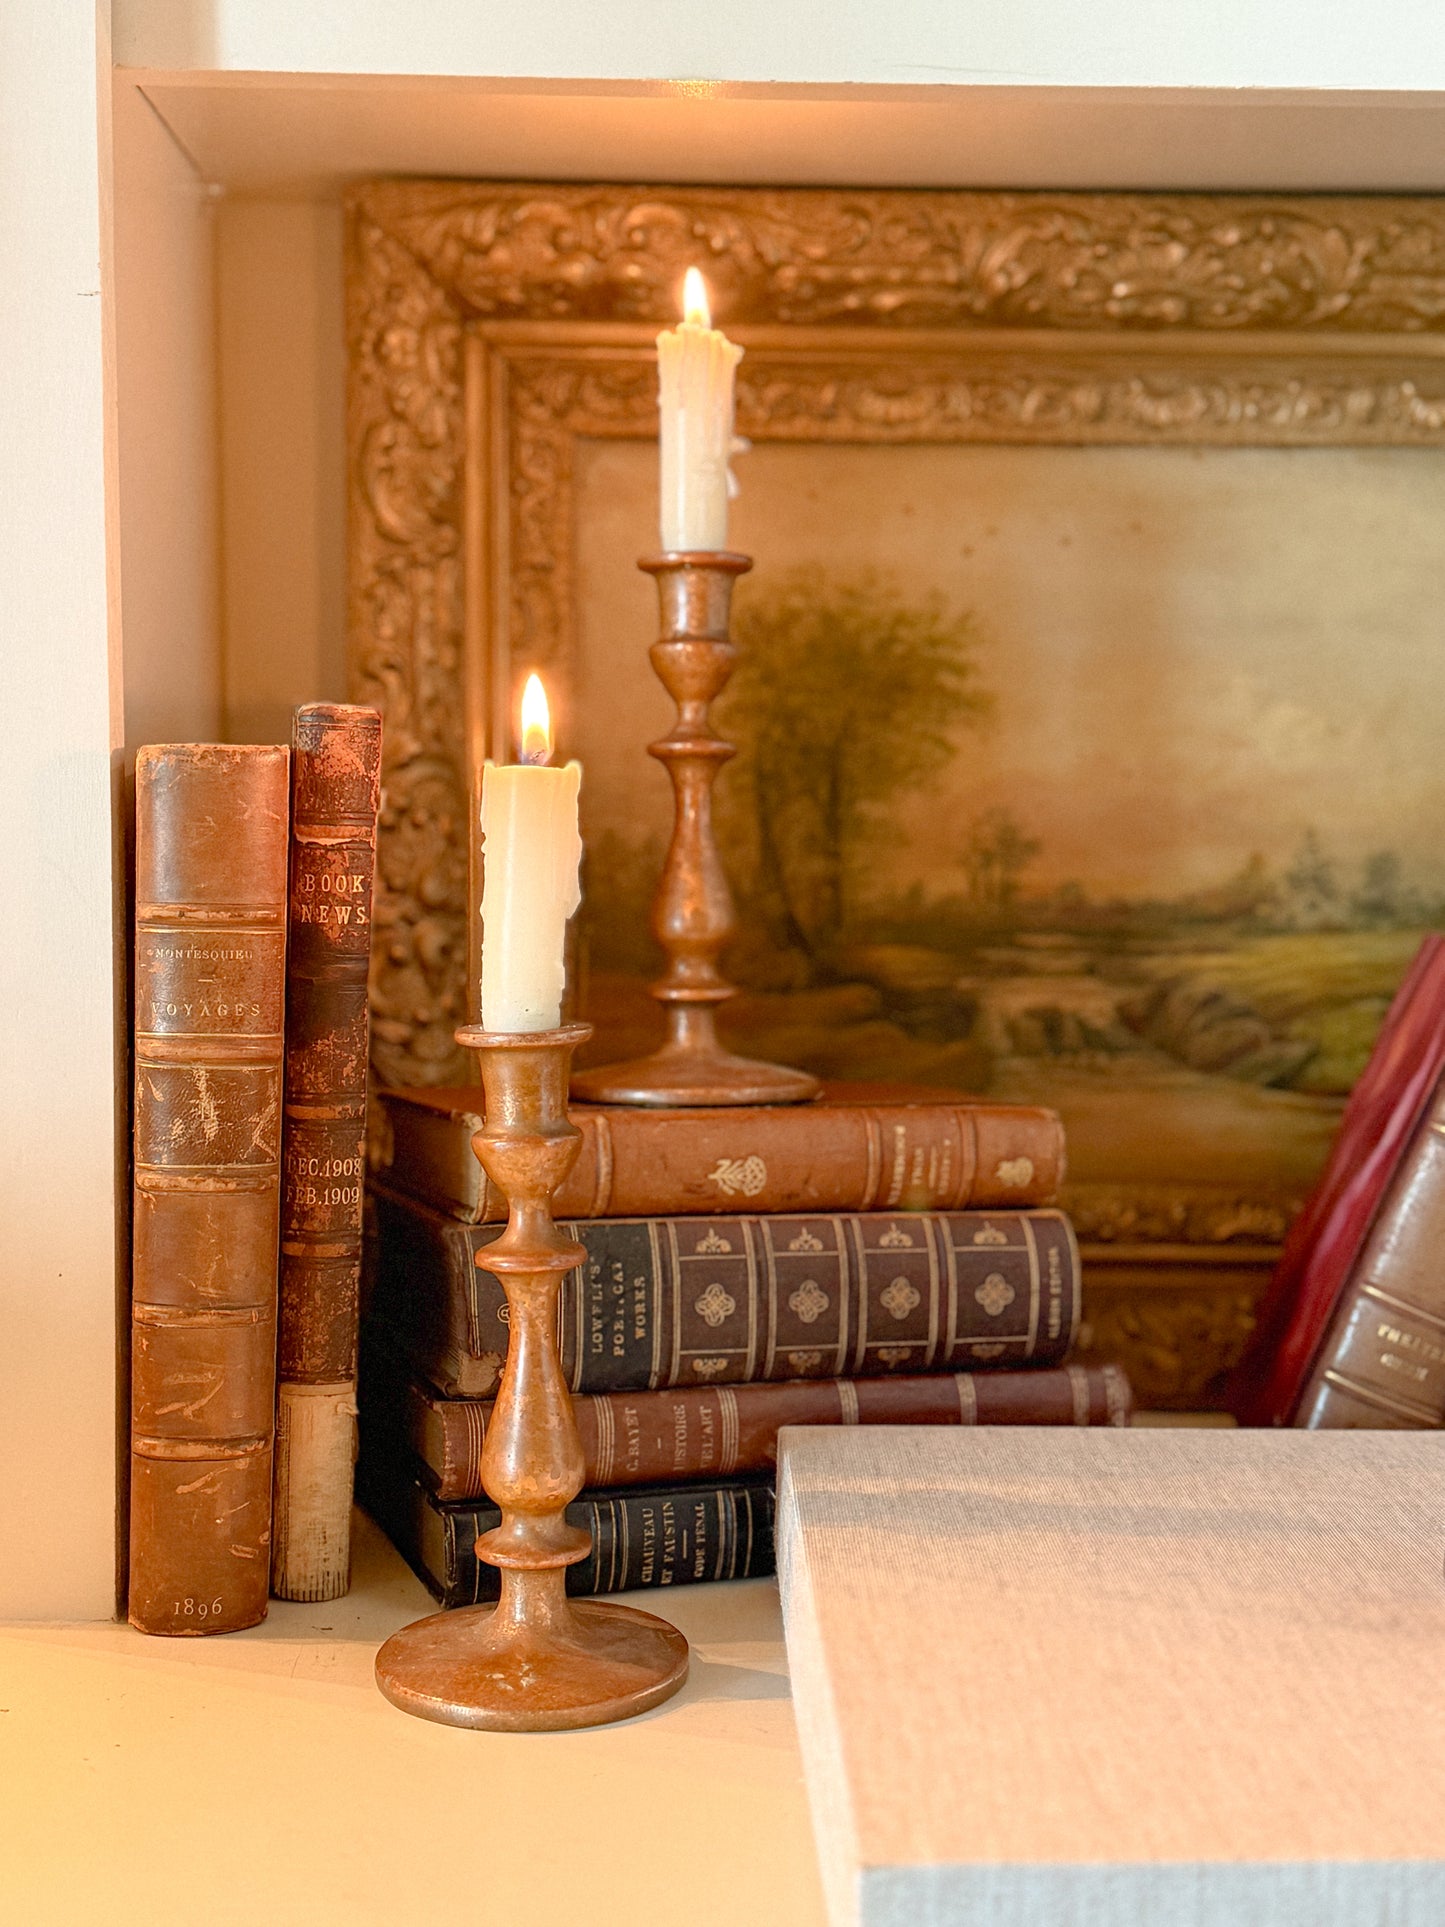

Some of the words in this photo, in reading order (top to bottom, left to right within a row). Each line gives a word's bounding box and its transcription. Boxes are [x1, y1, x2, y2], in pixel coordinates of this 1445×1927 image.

[304, 874, 365, 893] BOOK
[301, 904, 366, 925] NEWS
[155, 948, 253, 960] MONTESQUIEU
[152, 1002, 260, 1017] VOYAGES
[634, 1276, 646, 1340] WORKS
[625, 1406, 640, 1456] BAYET
[641, 1508, 655, 1582] CHAUVEAU
[662, 1502, 676, 1563] FAUSTIN
[694, 1547, 706, 1578] CODE
[661, 1568, 673, 1585] ET
[174, 1596, 223, 1621] 1896
